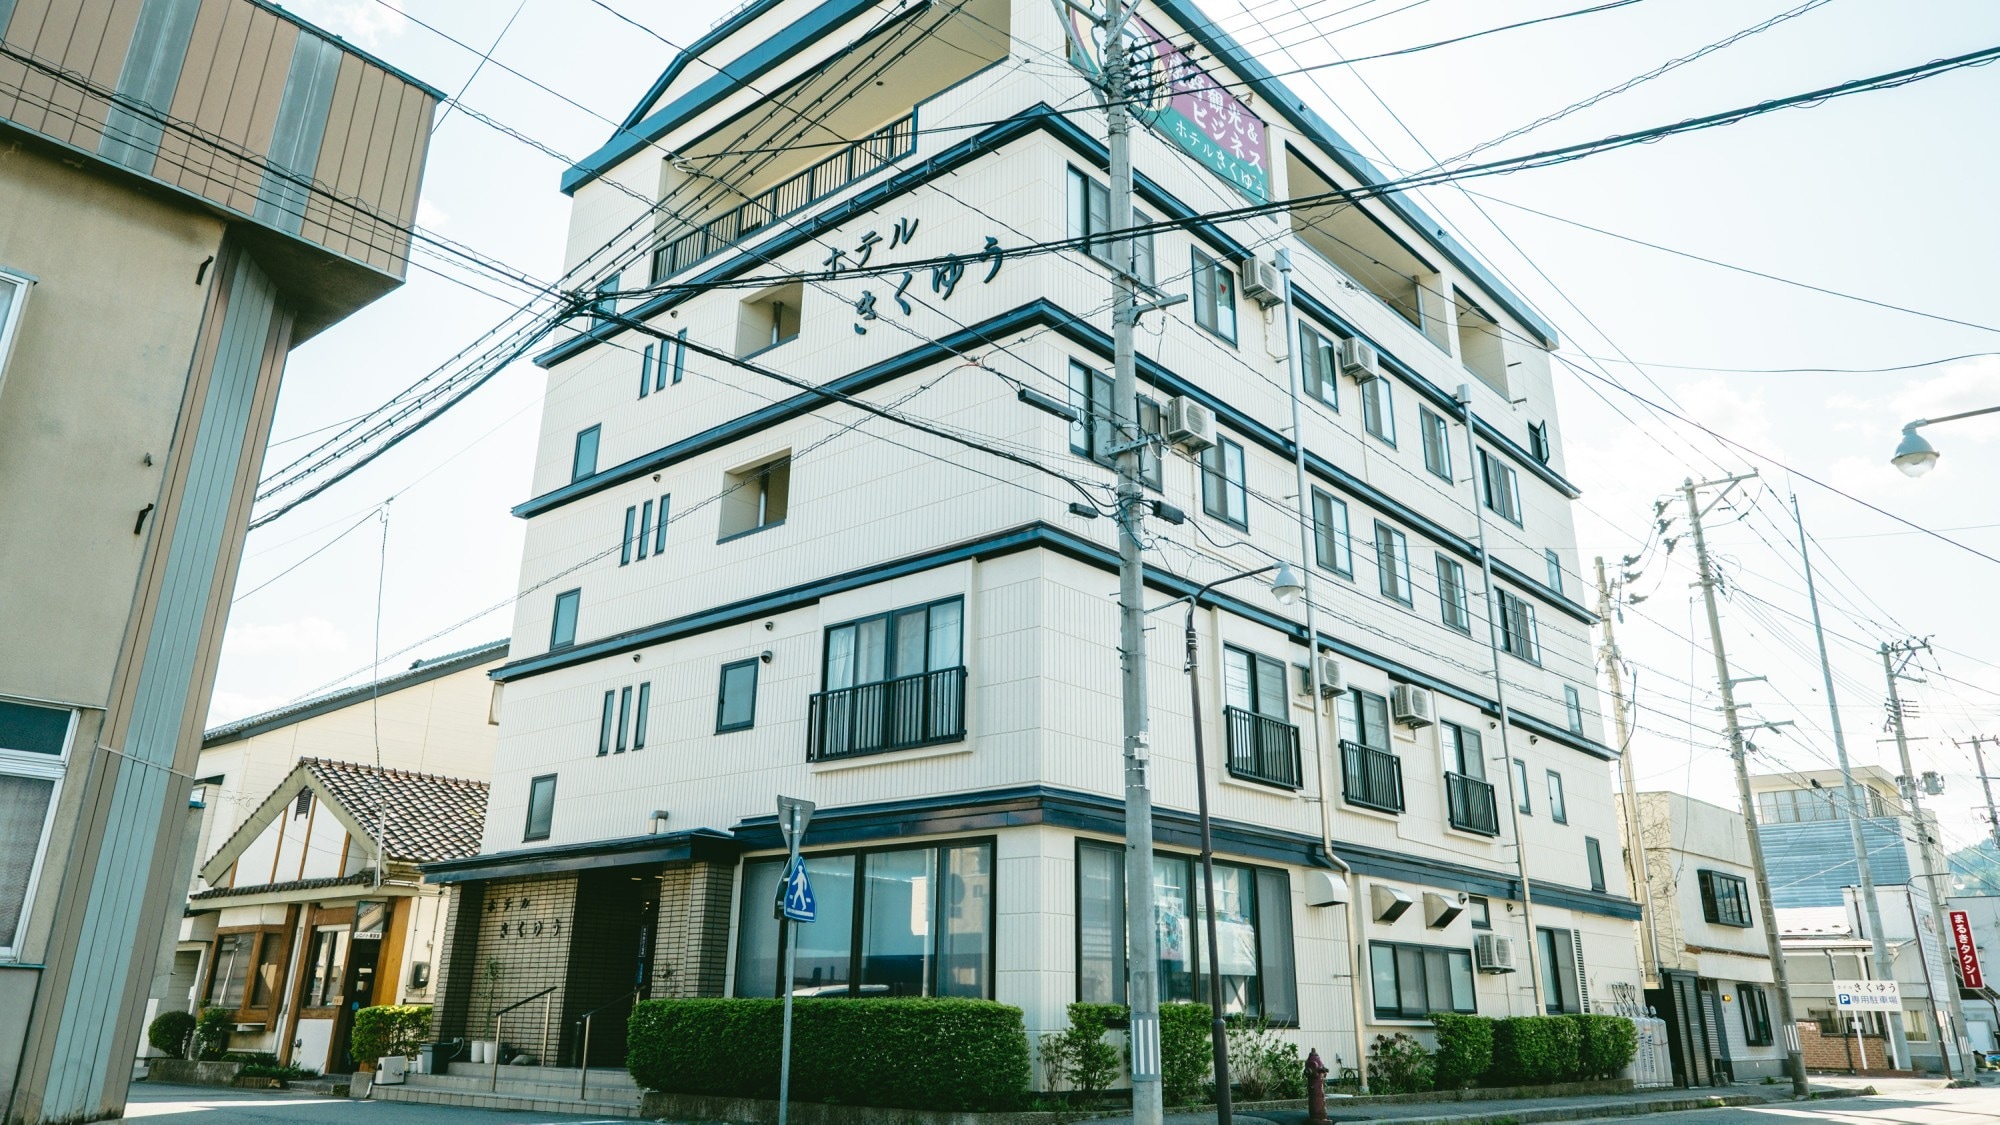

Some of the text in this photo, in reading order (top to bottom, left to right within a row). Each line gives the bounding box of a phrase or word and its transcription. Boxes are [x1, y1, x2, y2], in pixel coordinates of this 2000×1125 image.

[1193, 102, 1263, 174] ビジネス
[822, 217, 920, 282] ホテル
[488, 898, 530, 912] ホテル
[1954, 914, 1976, 985] まるきタクシー
[1840, 995, 1898, 1004] P 専用駐車場
